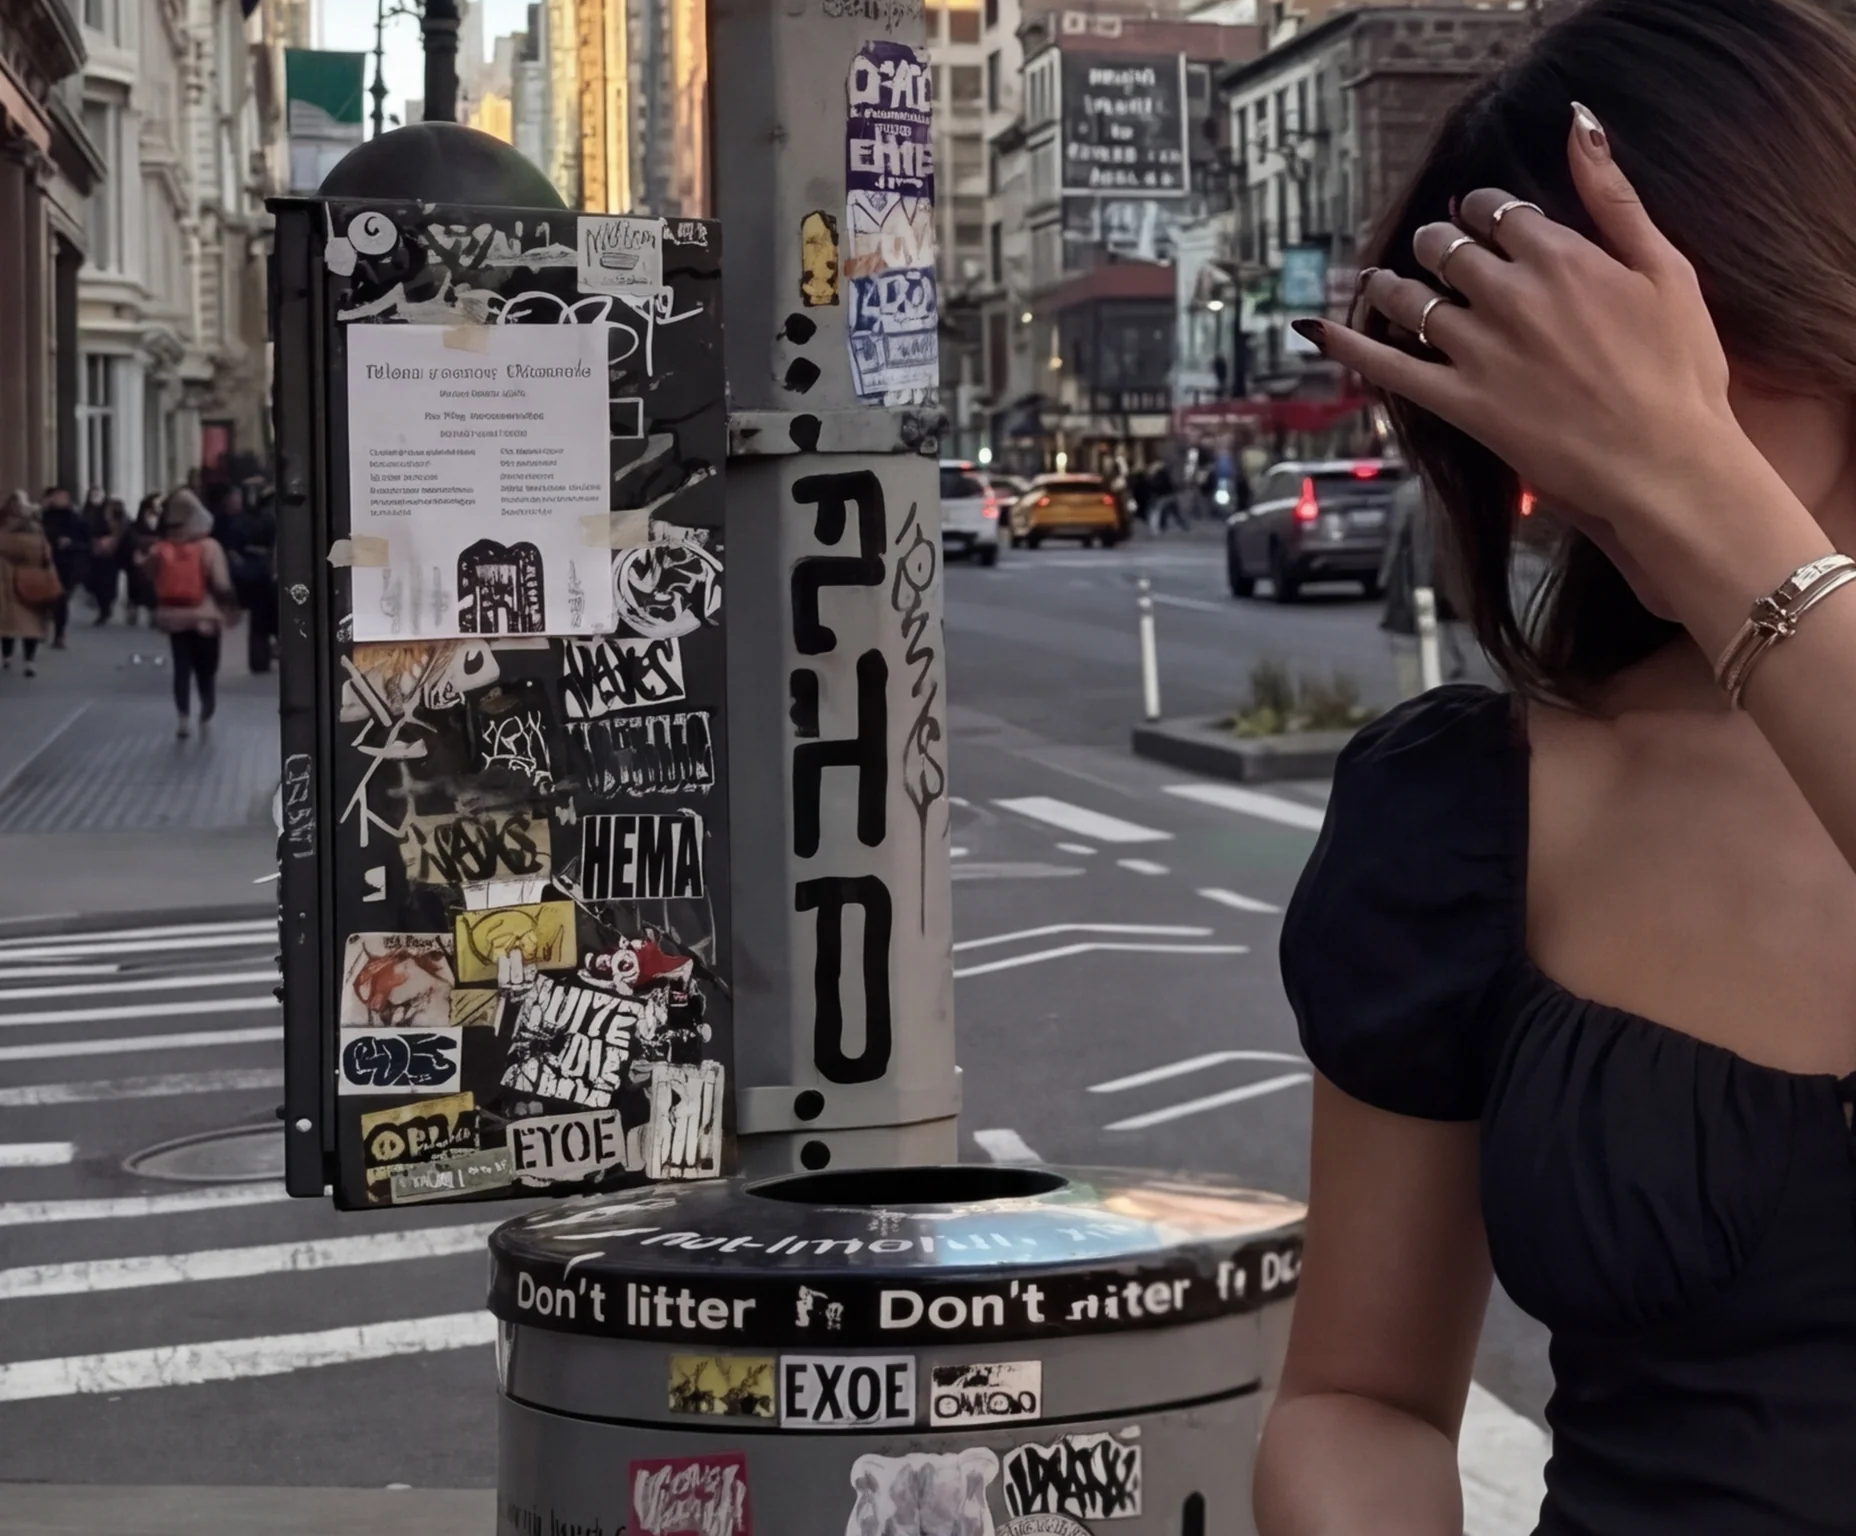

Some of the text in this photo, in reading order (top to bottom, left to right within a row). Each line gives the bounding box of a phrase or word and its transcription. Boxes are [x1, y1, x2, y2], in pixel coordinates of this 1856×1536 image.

[583, 816, 703, 898] HEMA
[517, 1270, 606, 1323] Don't
[626, 1282, 757, 1330] litter
[878, 1279, 1046, 1330] Don't
[785, 1362, 910, 1421] EXOE
